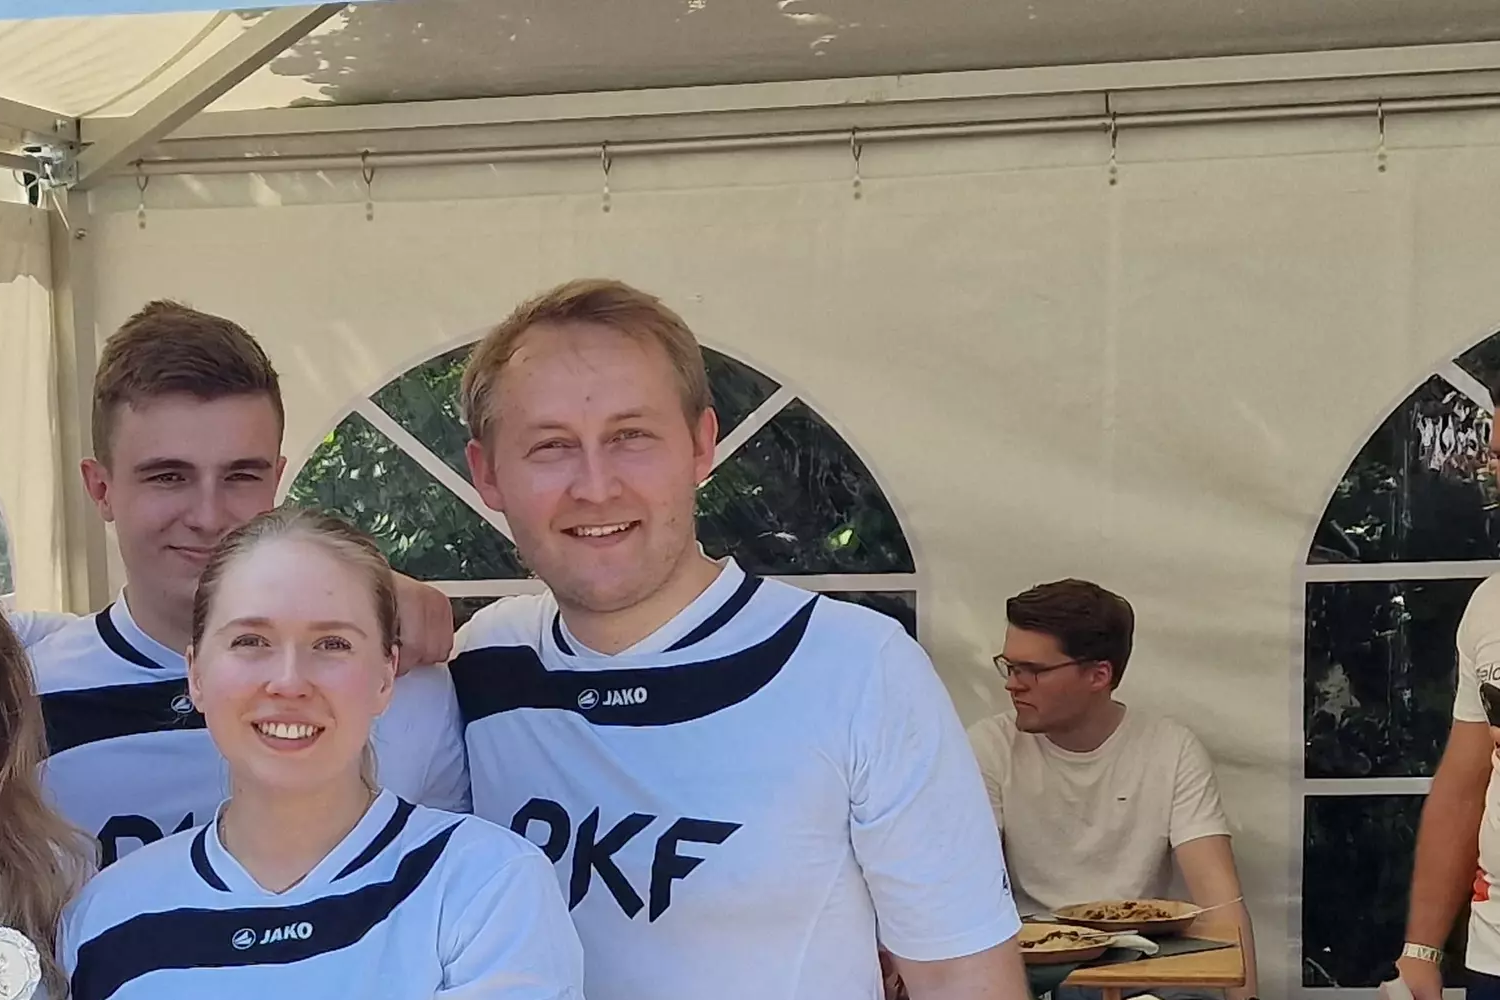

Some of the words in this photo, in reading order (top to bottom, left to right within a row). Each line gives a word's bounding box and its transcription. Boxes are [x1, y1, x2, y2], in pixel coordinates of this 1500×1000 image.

[602, 686, 648, 706] JAKO
[509, 797, 744, 923] PKF
[259, 921, 314, 945] JAKO
